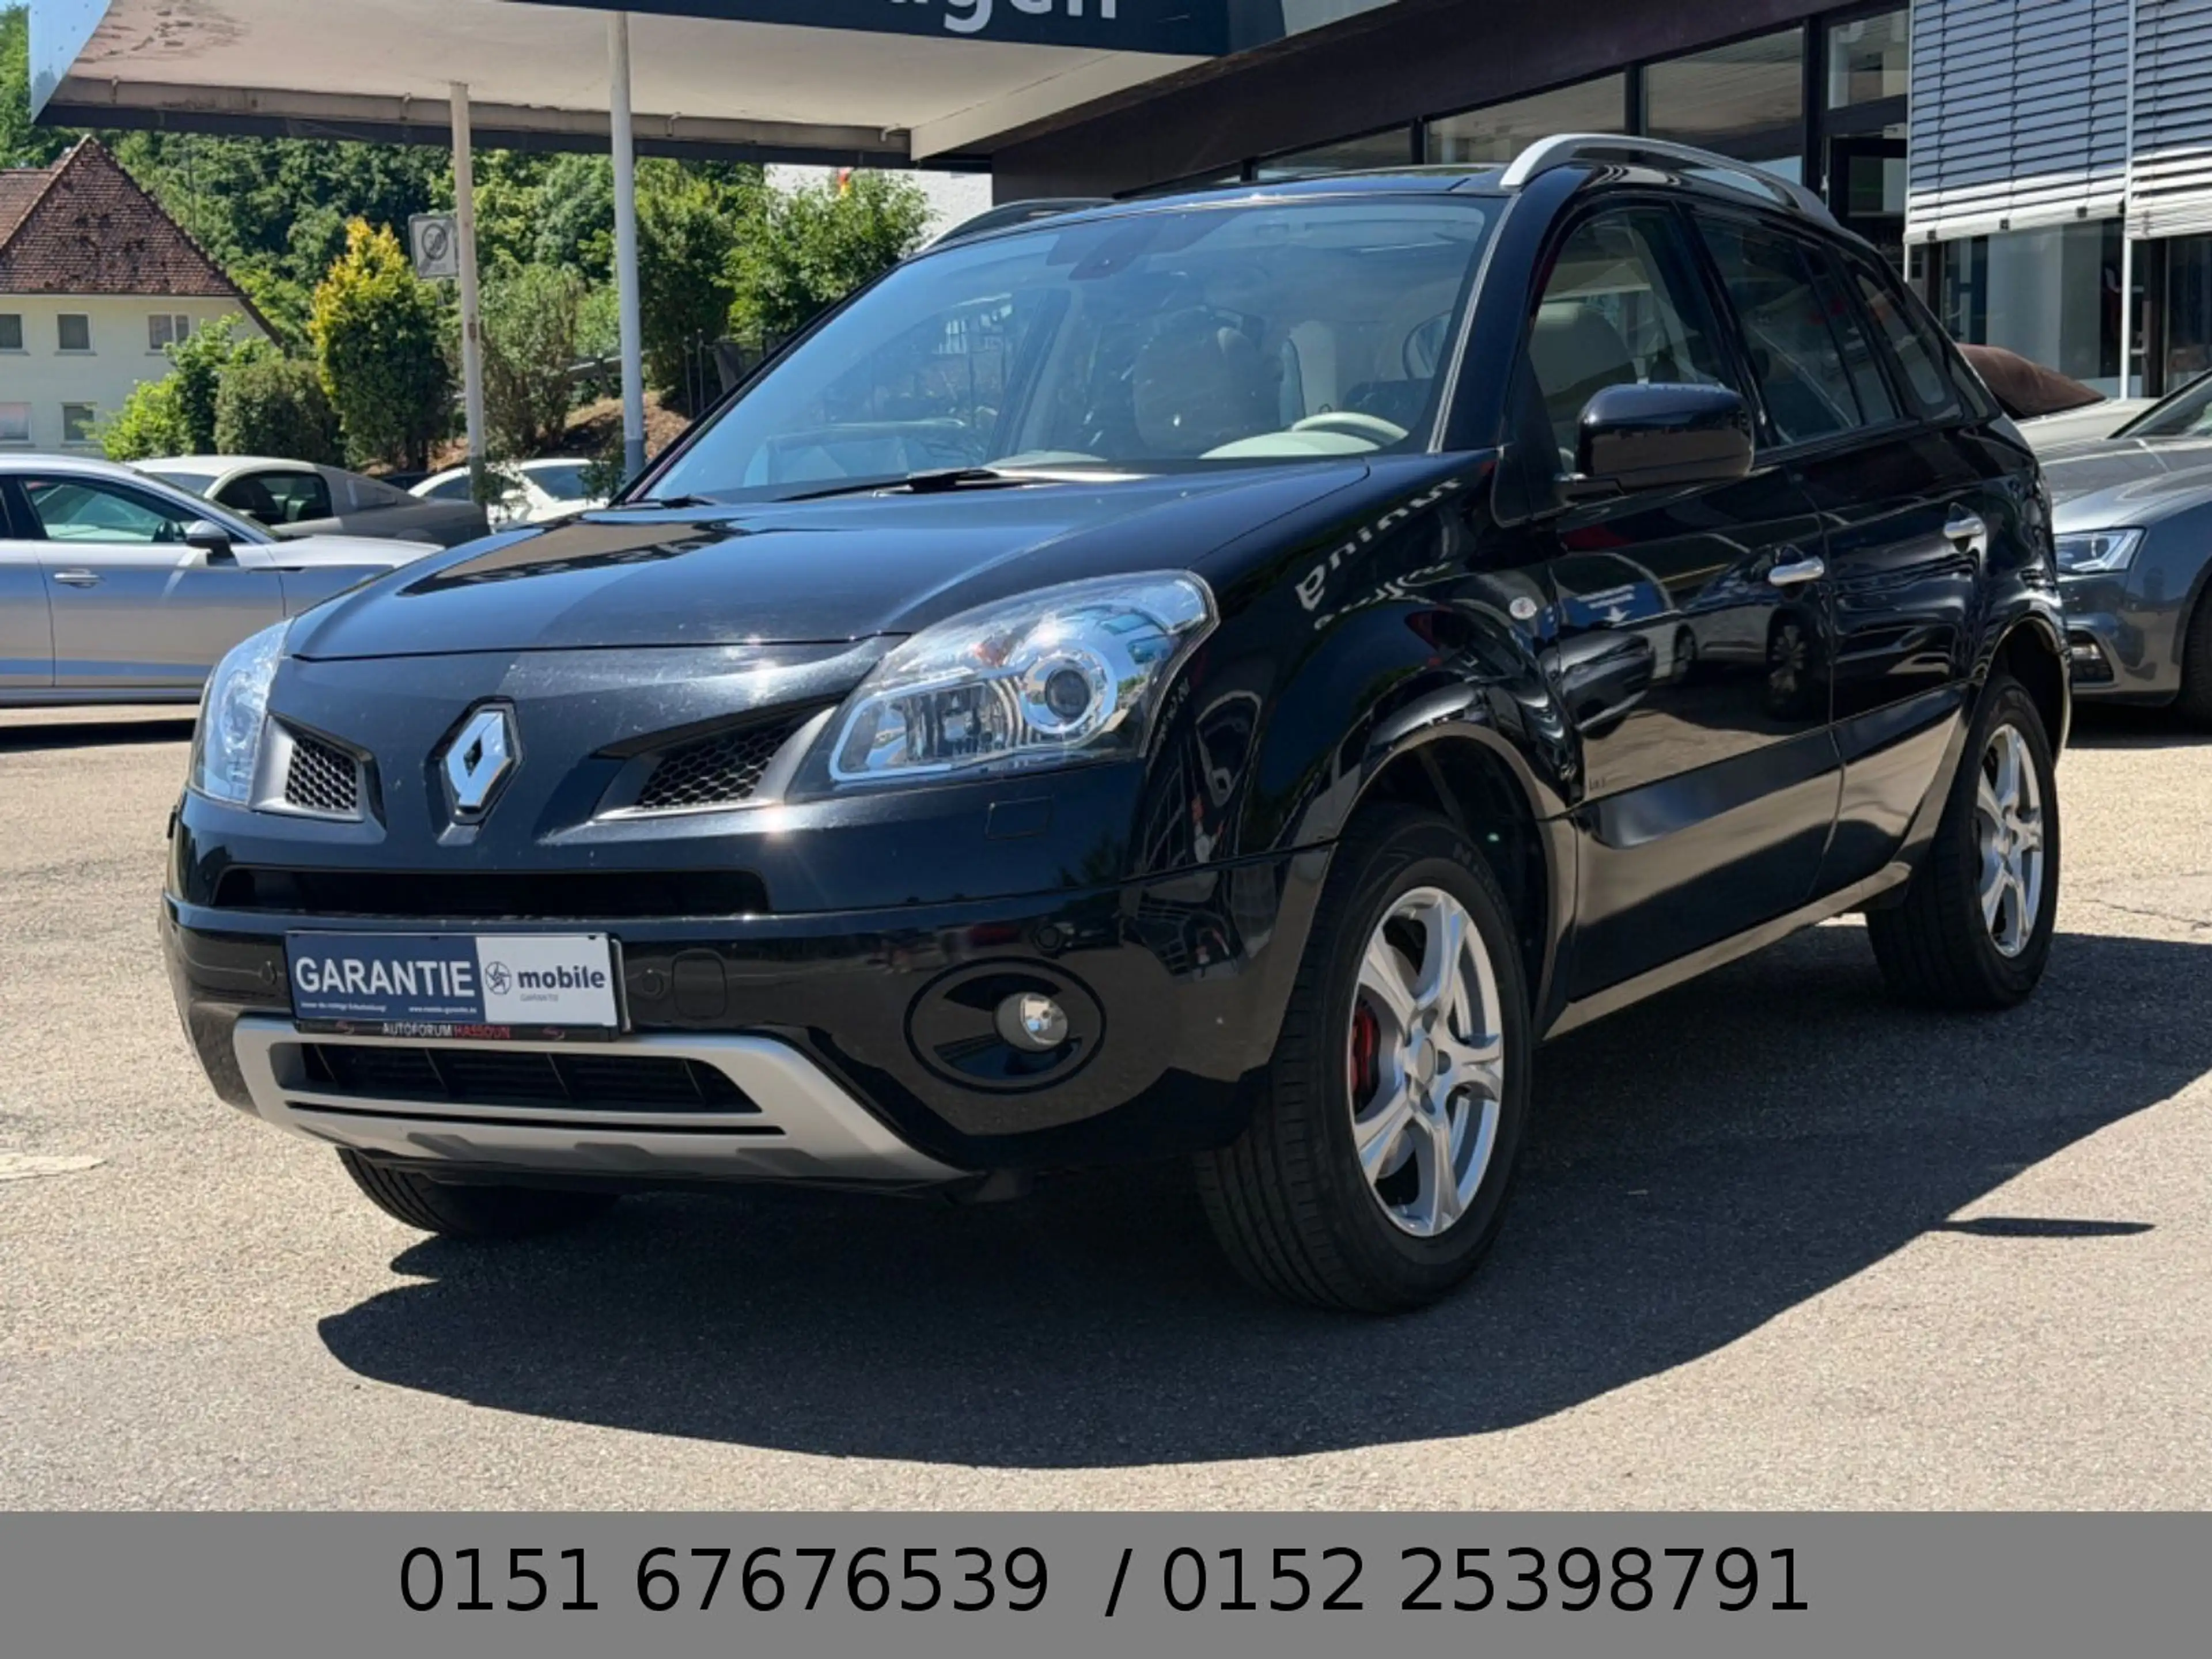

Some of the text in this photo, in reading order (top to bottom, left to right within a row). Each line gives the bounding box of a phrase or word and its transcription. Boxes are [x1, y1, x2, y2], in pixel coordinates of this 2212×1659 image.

[295, 956, 476, 998] GARANTIE
[518, 965, 605, 989] mobile
[382, 1022, 453, 1037] AUTOFORUM
